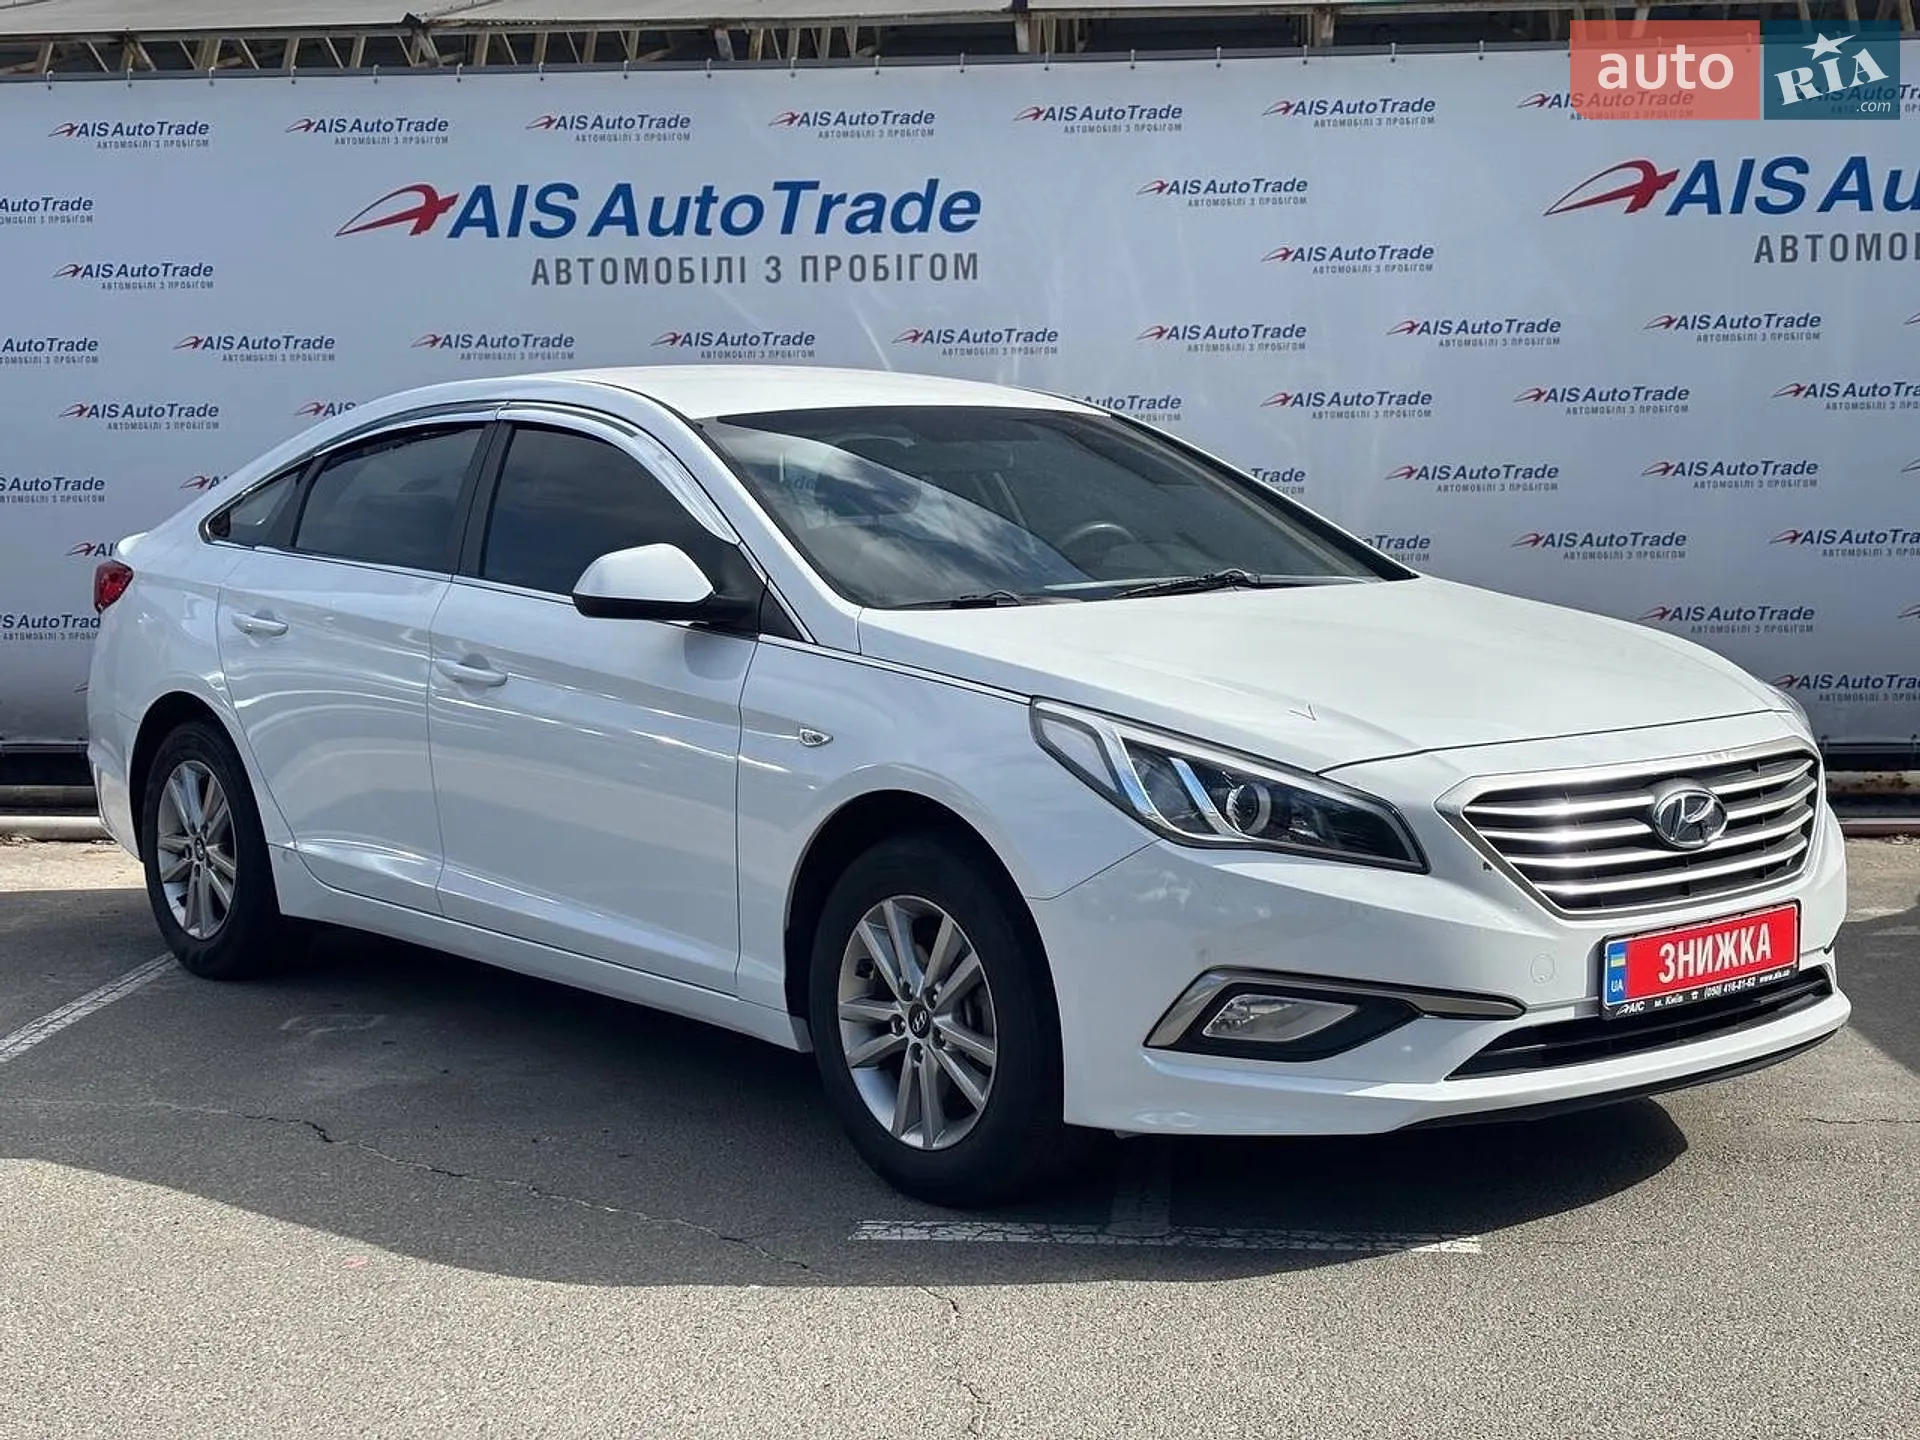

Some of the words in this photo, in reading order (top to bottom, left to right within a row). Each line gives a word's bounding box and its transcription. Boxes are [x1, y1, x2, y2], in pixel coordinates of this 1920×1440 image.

[1042, 107, 1077, 121] AIS
[1292, 100, 1328, 115] AIS
[312, 119, 346, 133] AIS
[553, 115, 587, 130] AIS
[797, 112, 831, 126] AIS
[75, 122, 108, 137] AIS
[1166, 180, 1201, 194] AIS
[1662, 157, 1809, 216] AIS
[445, 183, 578, 238] AIS
[588, 179, 981, 237] AutoTrade
[1292, 247, 1326, 261] AIS
[80, 264, 113, 278] AIS
[532, 257, 745, 285] АВТОМОБІЛІ
[766, 256, 781, 283] З
[801, 253, 977, 282] ПРОБІГОМ
[1418, 320, 1452, 335] AIS
[1674, 315, 1710, 330] AIS
[679, 332, 713, 347] AIS
[921, 329, 955, 344] AIS
[1167, 325, 1201, 340] AIS
[201, 336, 234, 350] AIS
[439, 334, 472, 348] AIS
[1543, 388, 1580, 402] AIS
[1803, 383, 1840, 398] AIS
[1291, 392, 1325, 407] AIS
[86, 404, 119, 418] AIS
[1251, 467, 1306, 482] Trade
[1416, 465, 1451, 480] AIS
[1671, 461, 1708, 476] AIS
[1541, 533, 1577, 547] AIS
[1800, 530, 1837, 544] AIS
[17, 614, 101, 629] AutoTrad
[1667, 607, 1704, 621] AIS
[1796, 675, 1833, 689] AIS
[1835, 674, 1920, 689] AutoTra
[1658, 923, 1772, 983] ЗНИЖКА
[1611, 978, 1624, 993] UA
